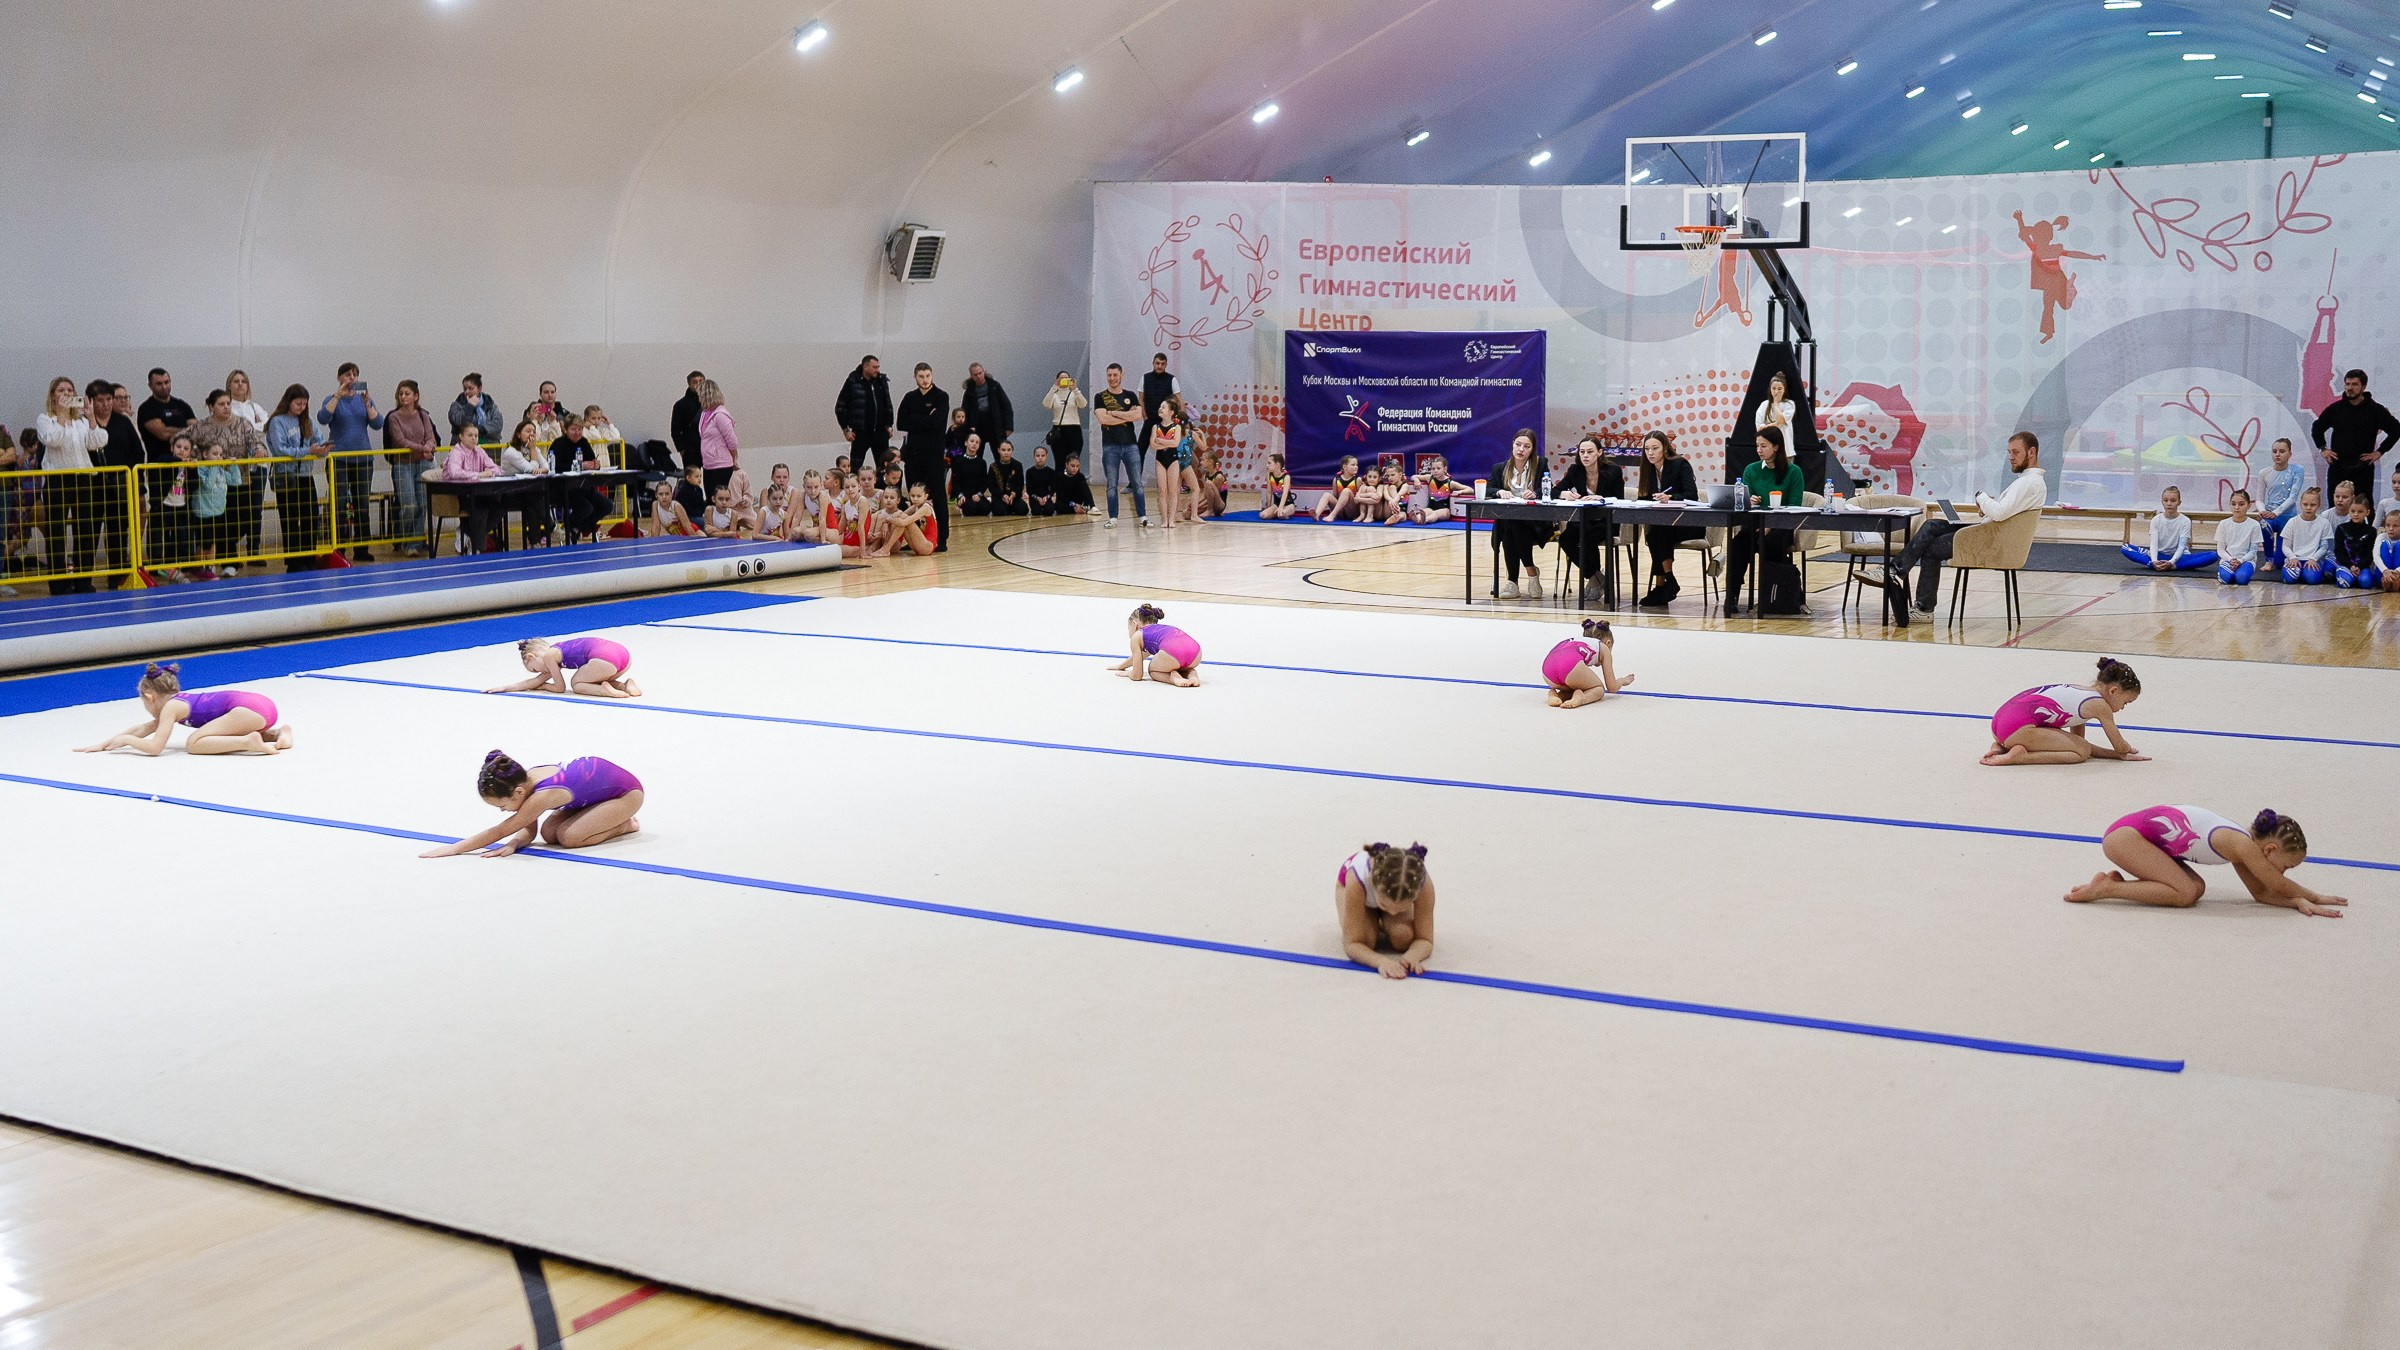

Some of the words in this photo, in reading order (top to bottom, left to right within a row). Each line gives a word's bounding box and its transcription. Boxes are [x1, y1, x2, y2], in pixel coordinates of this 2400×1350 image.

[1298, 239, 1472, 266] Европейский
[1298, 273, 1516, 302] Гимнастический
[1298, 307, 1373, 331] Центр
[1316, 346, 1362, 354] СпортВилл
[1302, 375, 1322, 387] Кубок
[1323, 375, 1351, 386] Москвы
[1352, 377, 1357, 386] и
[1358, 376, 1399, 386] Московской
[1400, 376, 1428, 387] области
[1429, 378, 1438, 387] по
[1439, 376, 1479, 388] Командной
[1480, 378, 1523, 387] гимнастике
[1377, 406, 1423, 420] Федерация
[1425, 407, 1472, 419] Командной
[1377, 421, 1426, 432] Гимнастики
[1428, 421, 1458, 433] России
